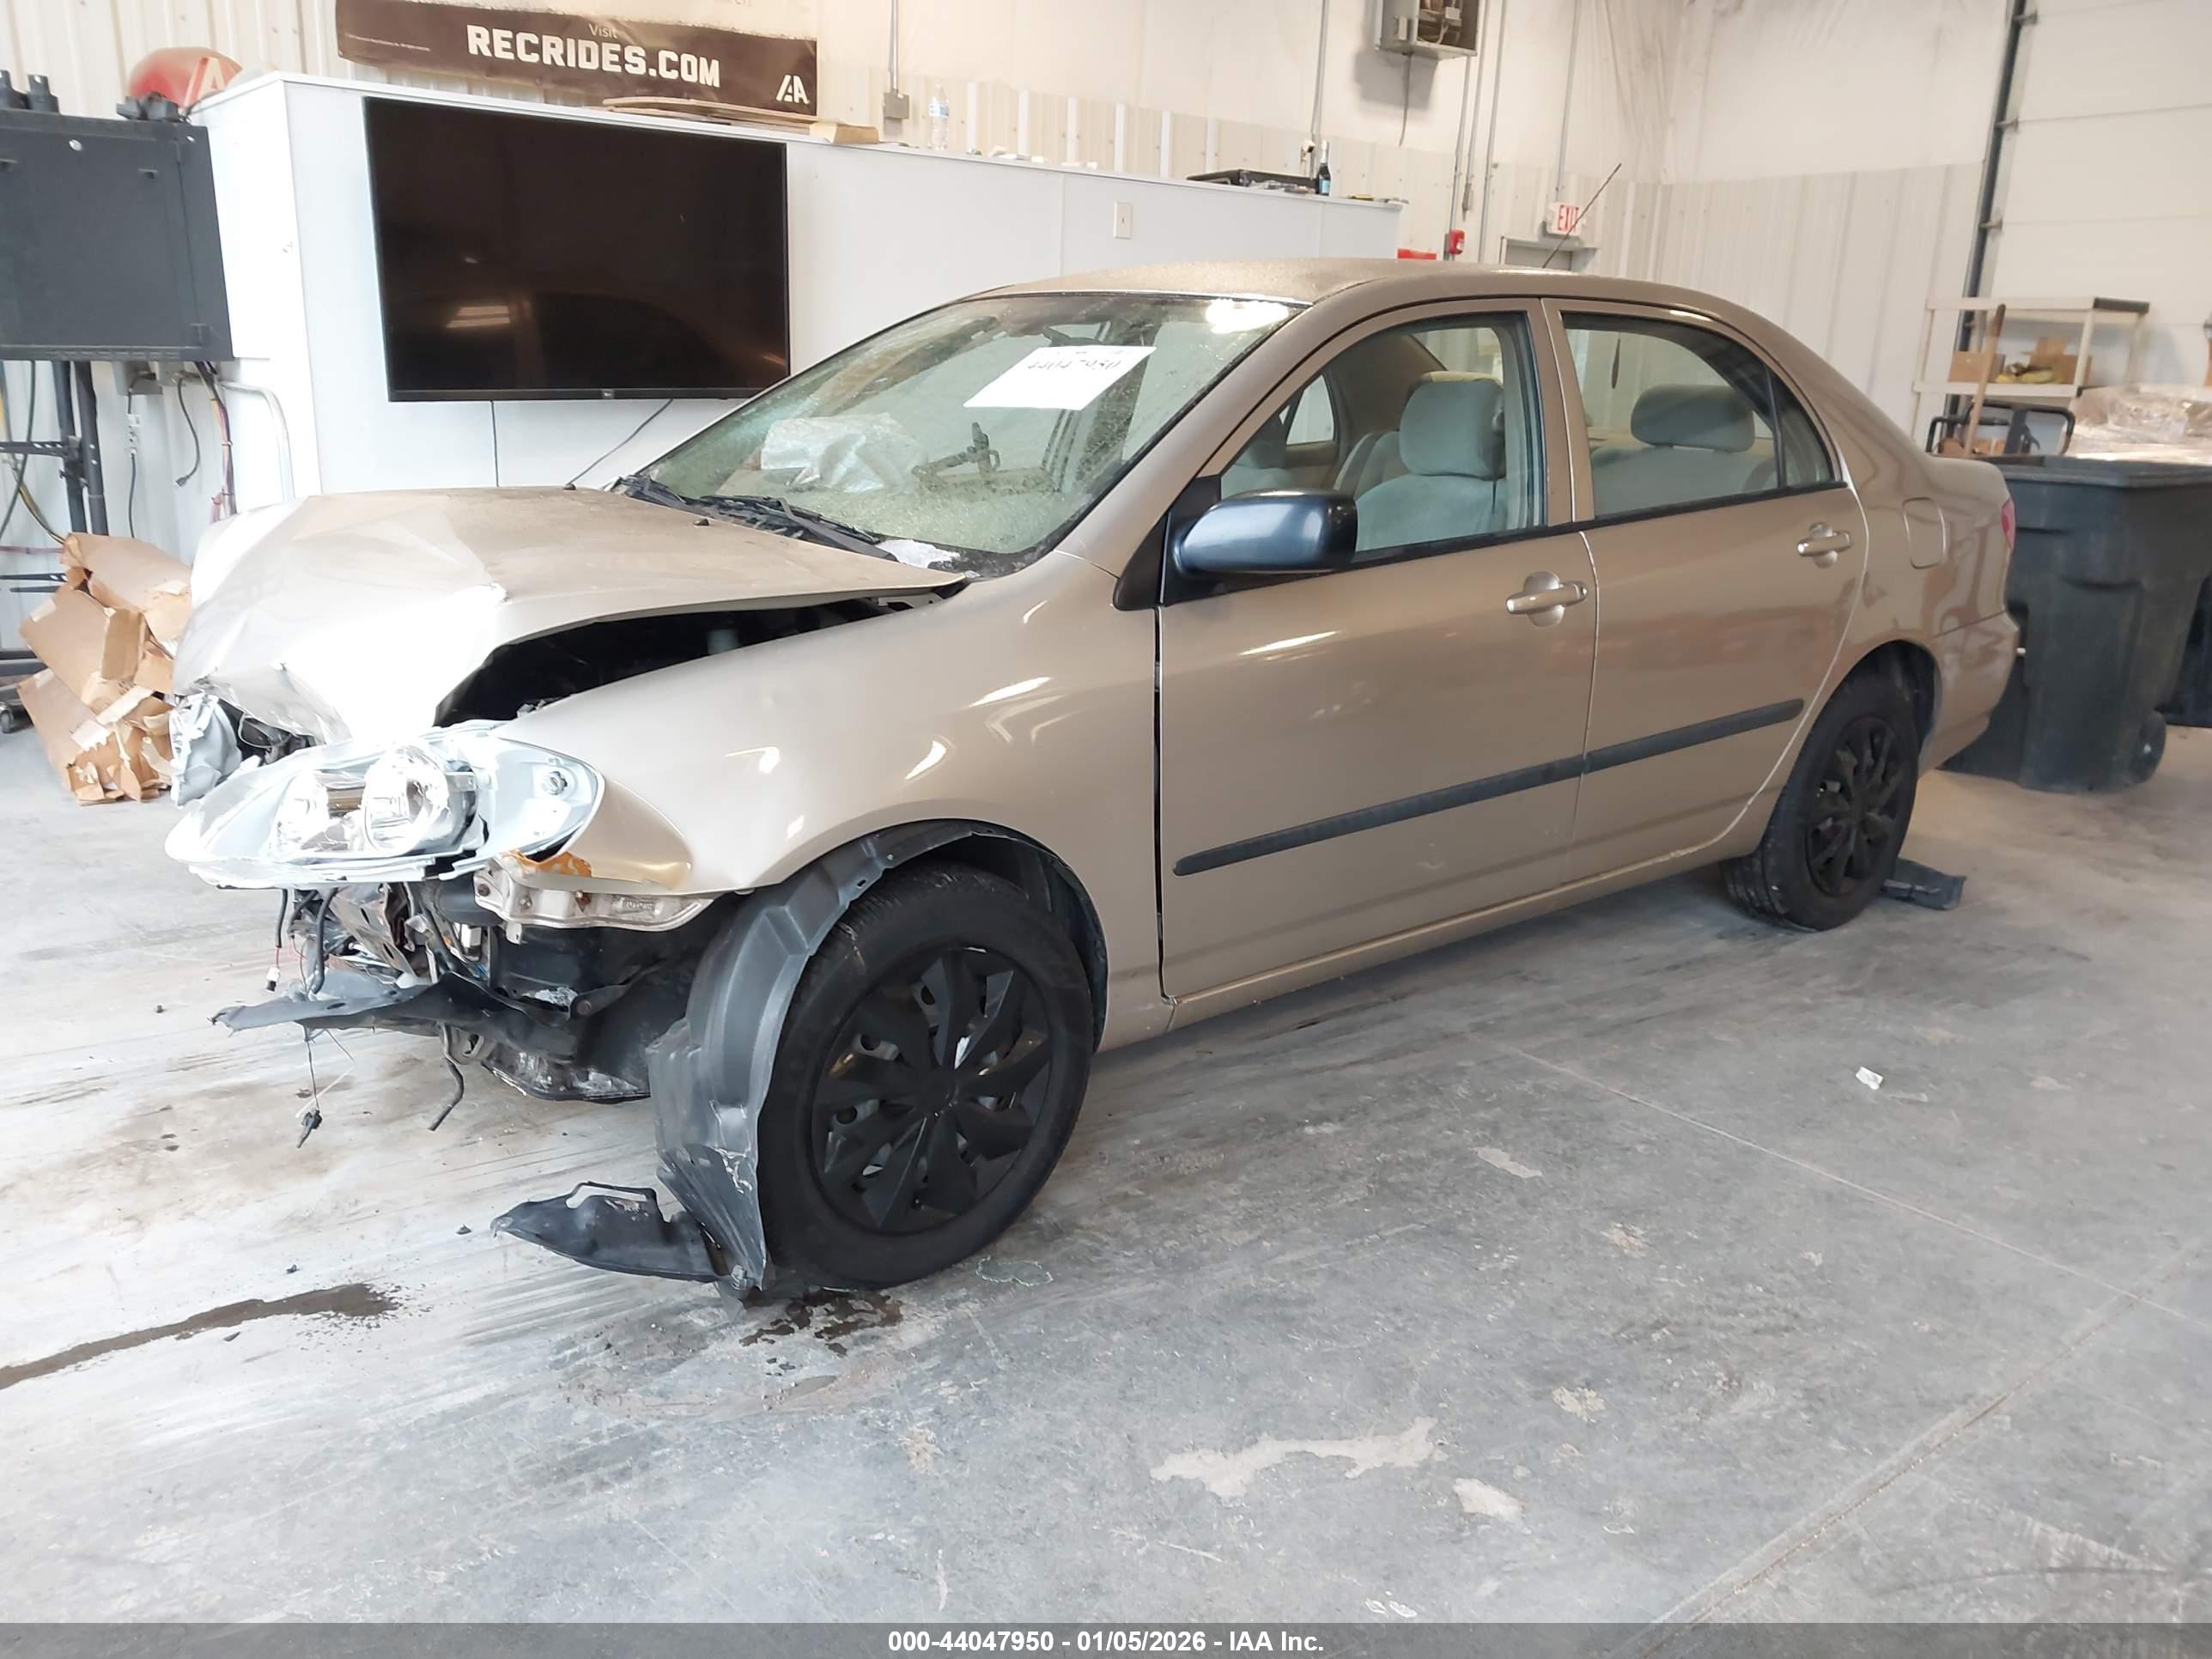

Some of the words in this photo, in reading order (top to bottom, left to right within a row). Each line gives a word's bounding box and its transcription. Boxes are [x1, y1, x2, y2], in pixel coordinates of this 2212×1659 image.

[587, 22, 618, 40] Visit
[466, 24, 720, 88] RECRIDES.COM
[1558, 204, 1581, 232] EXIT
